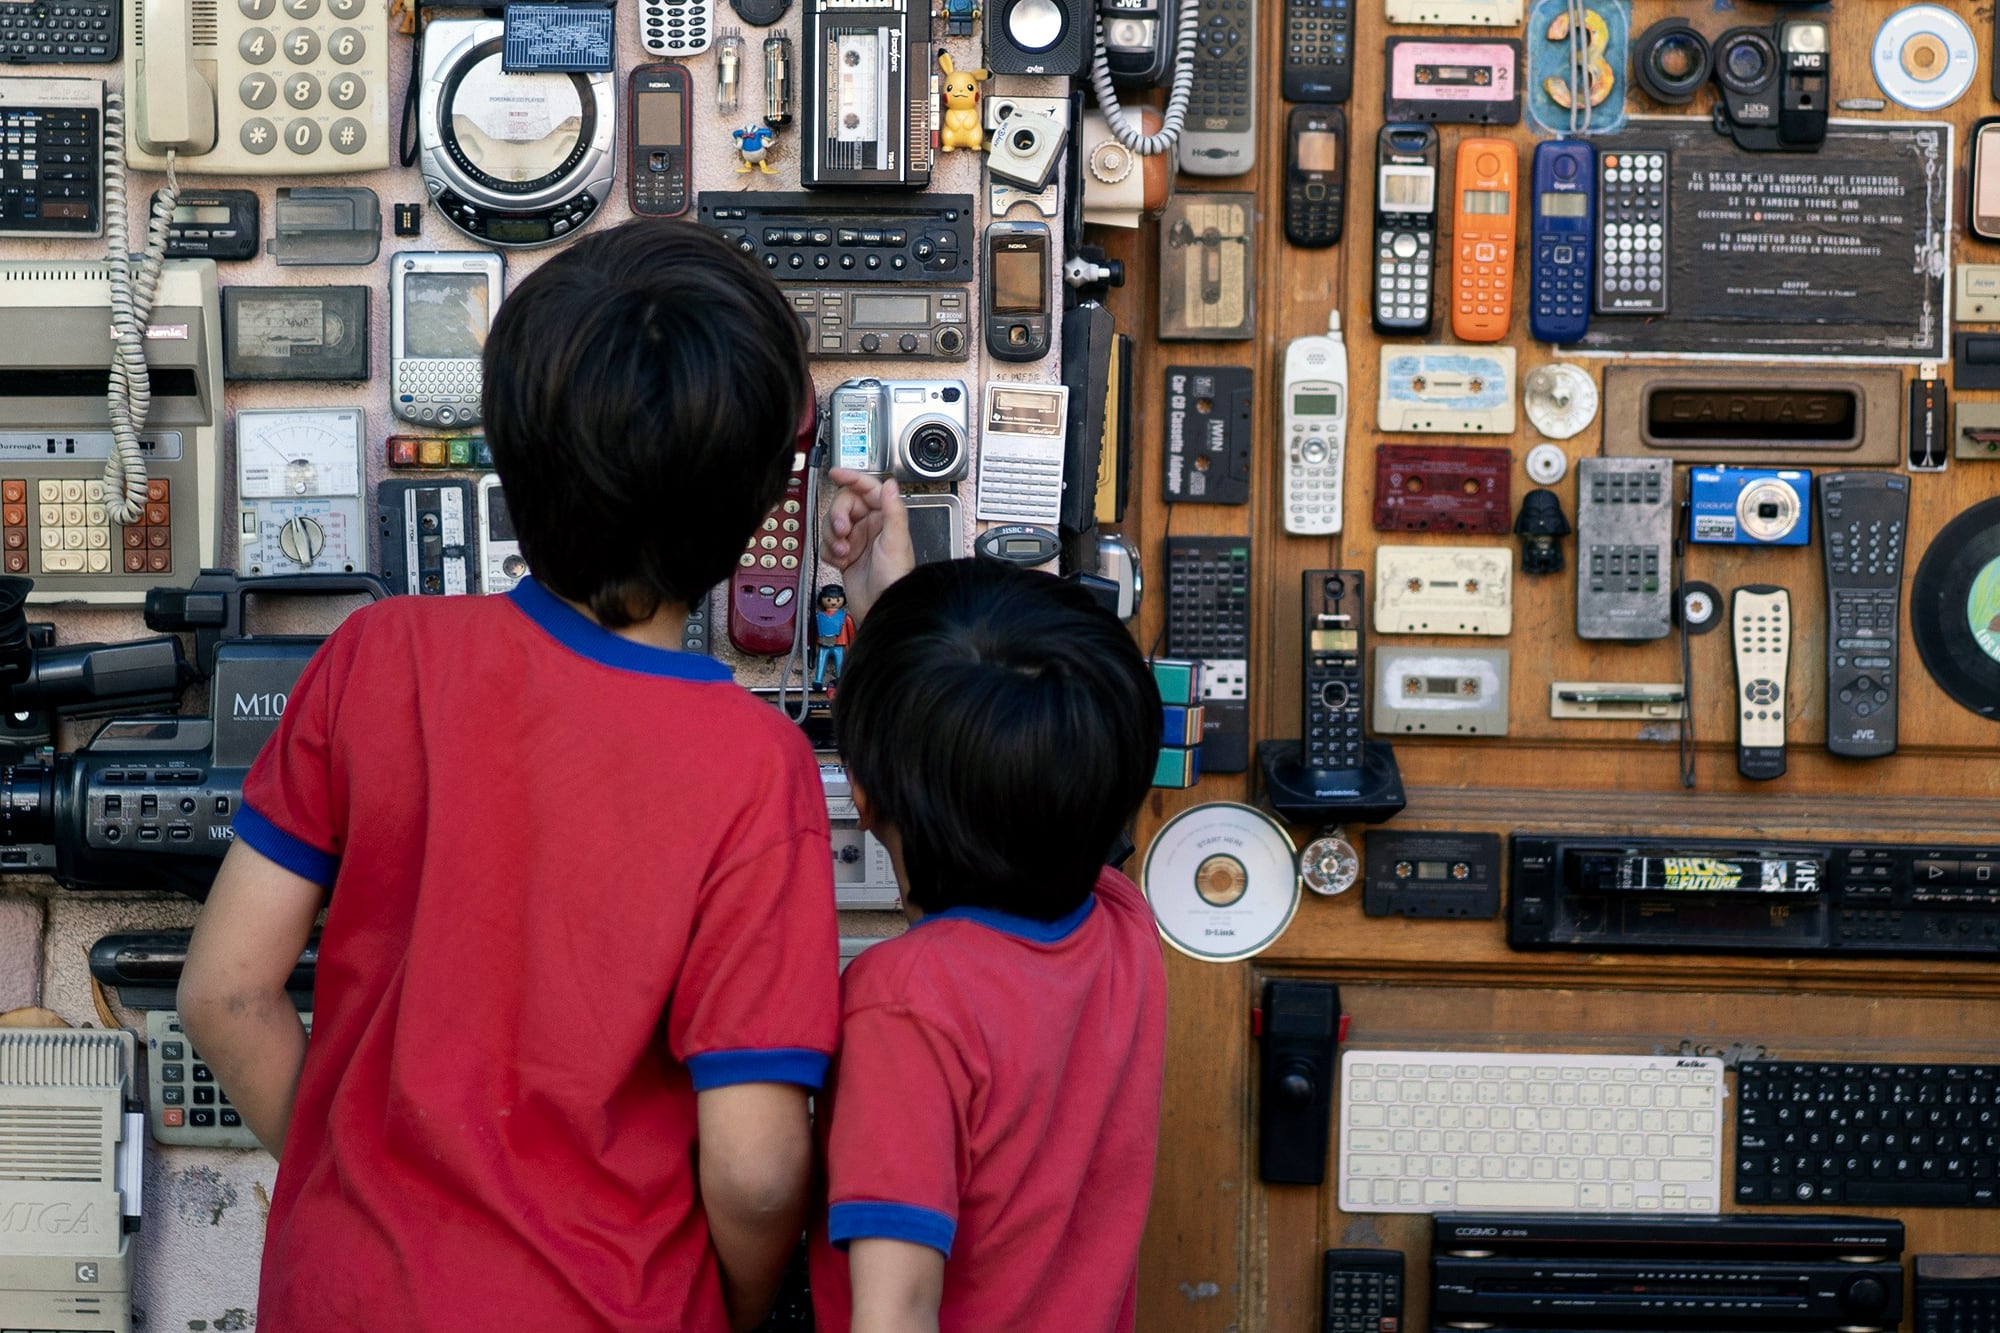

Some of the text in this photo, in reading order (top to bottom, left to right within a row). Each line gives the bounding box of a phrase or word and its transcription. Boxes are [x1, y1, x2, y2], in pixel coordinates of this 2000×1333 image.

[250, 35, 354, 55] 4 5 6
[1793, 55, 1820, 66] JVC
[1497, 67, 1508, 80] 2
[252, 81, 354, 101] 7 8 9
[295, 125, 354, 146] 0 #
[1192, 149, 1240, 158] Hond
[1392, 155, 1425, 163] Panasonic
[1692, 172, 1703, 181] EL
[1741, 173, 1752, 182] DE
[1758, 174, 1774, 183] LOS
[1710, 182, 1742, 192] DONADO
[1748, 183, 1764, 192] POR
[1805, 198, 1837, 209] TIENES
[1171, 375, 1187, 393] Car
[1171, 395, 1186, 409] CD
[1671, 396, 1828, 422] CARTAS
[1170, 411, 1185, 453] Cassette
[1697, 474, 1720, 482] Nikon
[47, 489, 53, 497] 7
[47, 512, 100, 520] 4 5 6
[71, 535, 78, 543] 2
[95, 535, 102, 543] 3
[1975, 628, 1995, 651] LOS
[233, 693, 287, 716] M10
[1853, 729, 1875, 740] JVC
[210, 825, 235, 840] VHS
[1197, 836, 1244, 848] START HERE
[1664, 857, 1727, 876] BACK
[1665, 875, 1742, 890] TO FUTURE
[197, 1069, 206, 1078] 4
[166, 1092, 178, 1100] CE
[1779, 1109, 1939, 1121] Q W E R T Y U
[1785, 1134, 1994, 1146] A S D F G H J K L
[1797, 1159, 1958, 1170] Z X C V B N M
[1455, 1228, 1497, 1236] COSMO
